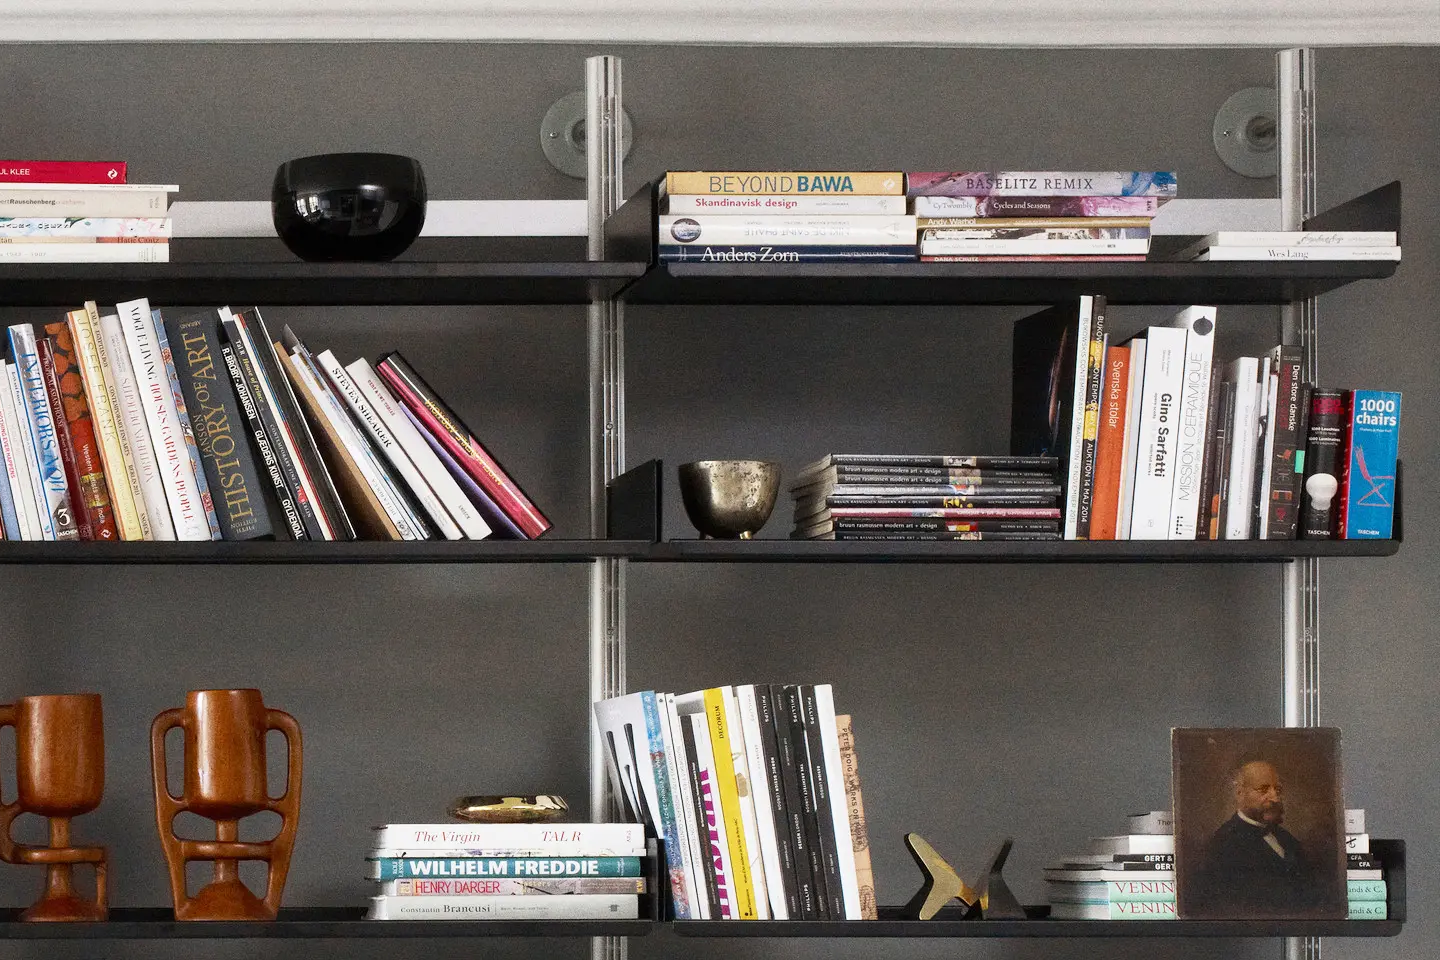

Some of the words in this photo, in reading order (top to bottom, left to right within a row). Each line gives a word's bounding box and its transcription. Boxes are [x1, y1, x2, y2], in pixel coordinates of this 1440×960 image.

[710, 176, 793, 192] BEYOND
[797, 176, 853, 192] BAWA
[966, 179, 1037, 190] BASELITZ
[1044, 178, 1093, 189] REMIX
[696, 199, 761, 208] Skandinavisk
[765, 199, 797, 209] design
[994, 202, 1012, 210] Cycles
[701, 247, 756, 262] Anders
[760, 247, 800, 262] Zorn
[128, 306, 144, 341] VOGUE
[139, 343, 157, 381] LIVING
[181, 334, 216, 381] ART
[1110, 361, 1124, 399] Svenska
[1291, 365, 1300, 384] Den
[192, 382, 209, 402] OF
[1290, 385, 1299, 401] store
[332, 368, 359, 405] STEVEN
[357, 405, 392, 448] SHEARER
[1108, 402, 1120, 428] stolar
[1159, 393, 1172, 423] Gino
[1359, 399, 1396, 413] 1000
[1288, 403, 1297, 431] danske
[1355, 412, 1397, 426] chairs
[193, 414, 210, 458] JANSON
[1154, 427, 1169, 477] Sarfatti
[202, 404, 250, 522] HISTORY
[266, 465, 283, 489] KUNST
[281, 499, 303, 540] GYLDENDAL
[414, 831, 438, 843] The
[442, 831, 481, 844] Virgin
[541, 831, 570, 842] TAL
[571, 831, 582, 842] R
[409, 860, 508, 875] WILHELM
[514, 859, 599, 875] FREDDIE
[415, 880, 451, 894] HENRY
[454, 880, 500, 893] DARGER
[443, 904, 491, 913] Brancusi
